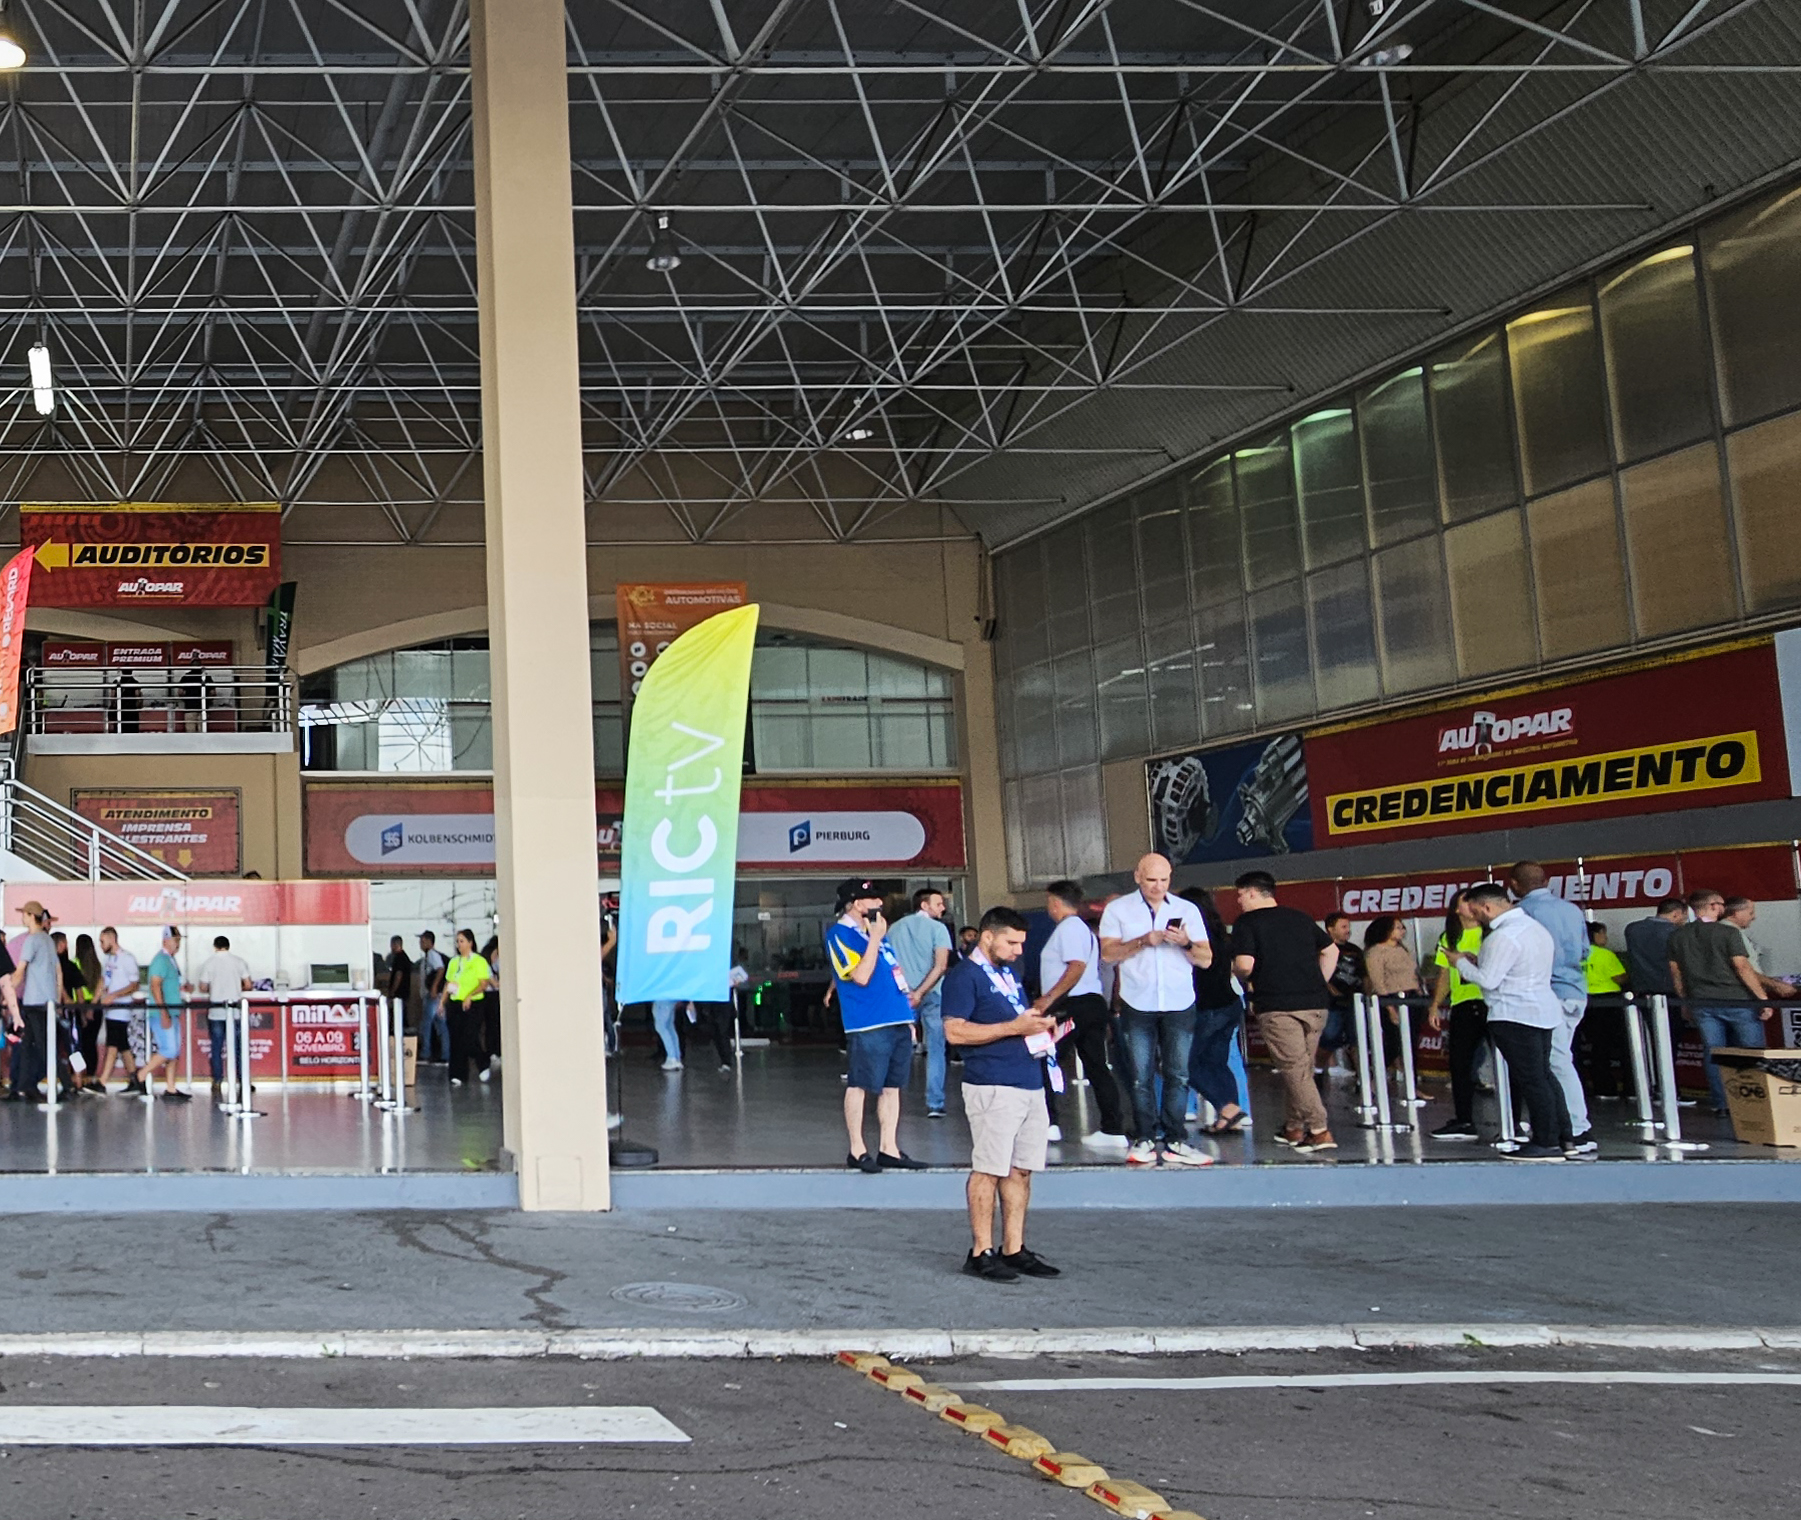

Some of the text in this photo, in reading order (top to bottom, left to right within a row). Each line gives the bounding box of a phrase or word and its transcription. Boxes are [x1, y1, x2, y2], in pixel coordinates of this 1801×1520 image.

[74, 542, 267, 564] AUDITÓRIOS
[118, 579, 184, 595] AUTOPAR
[665, 595, 741, 604] AUTOMOTIVAS
[112, 655, 163, 663] PREMIUM
[1439, 708, 1573, 753] AUTOPAR
[1332, 740, 1746, 828] CREDENCIAMENTO
[104, 809, 209, 819] ATENDIMENTO
[121, 823, 192, 832] IMPRENSA
[407, 833, 495, 844] KOLBENSCHMID
[815, 830, 871, 841] PIERBURG
[128, 890, 241, 916] AUTOPAR
[295, 1031, 312, 1043] 06
[314, 1031, 326, 1043] A
[327, 1031, 343, 1043] 09
[293, 1044, 346, 1052] NOVEMBRO
[299, 1056, 362, 1065] BELO HORIZONT
